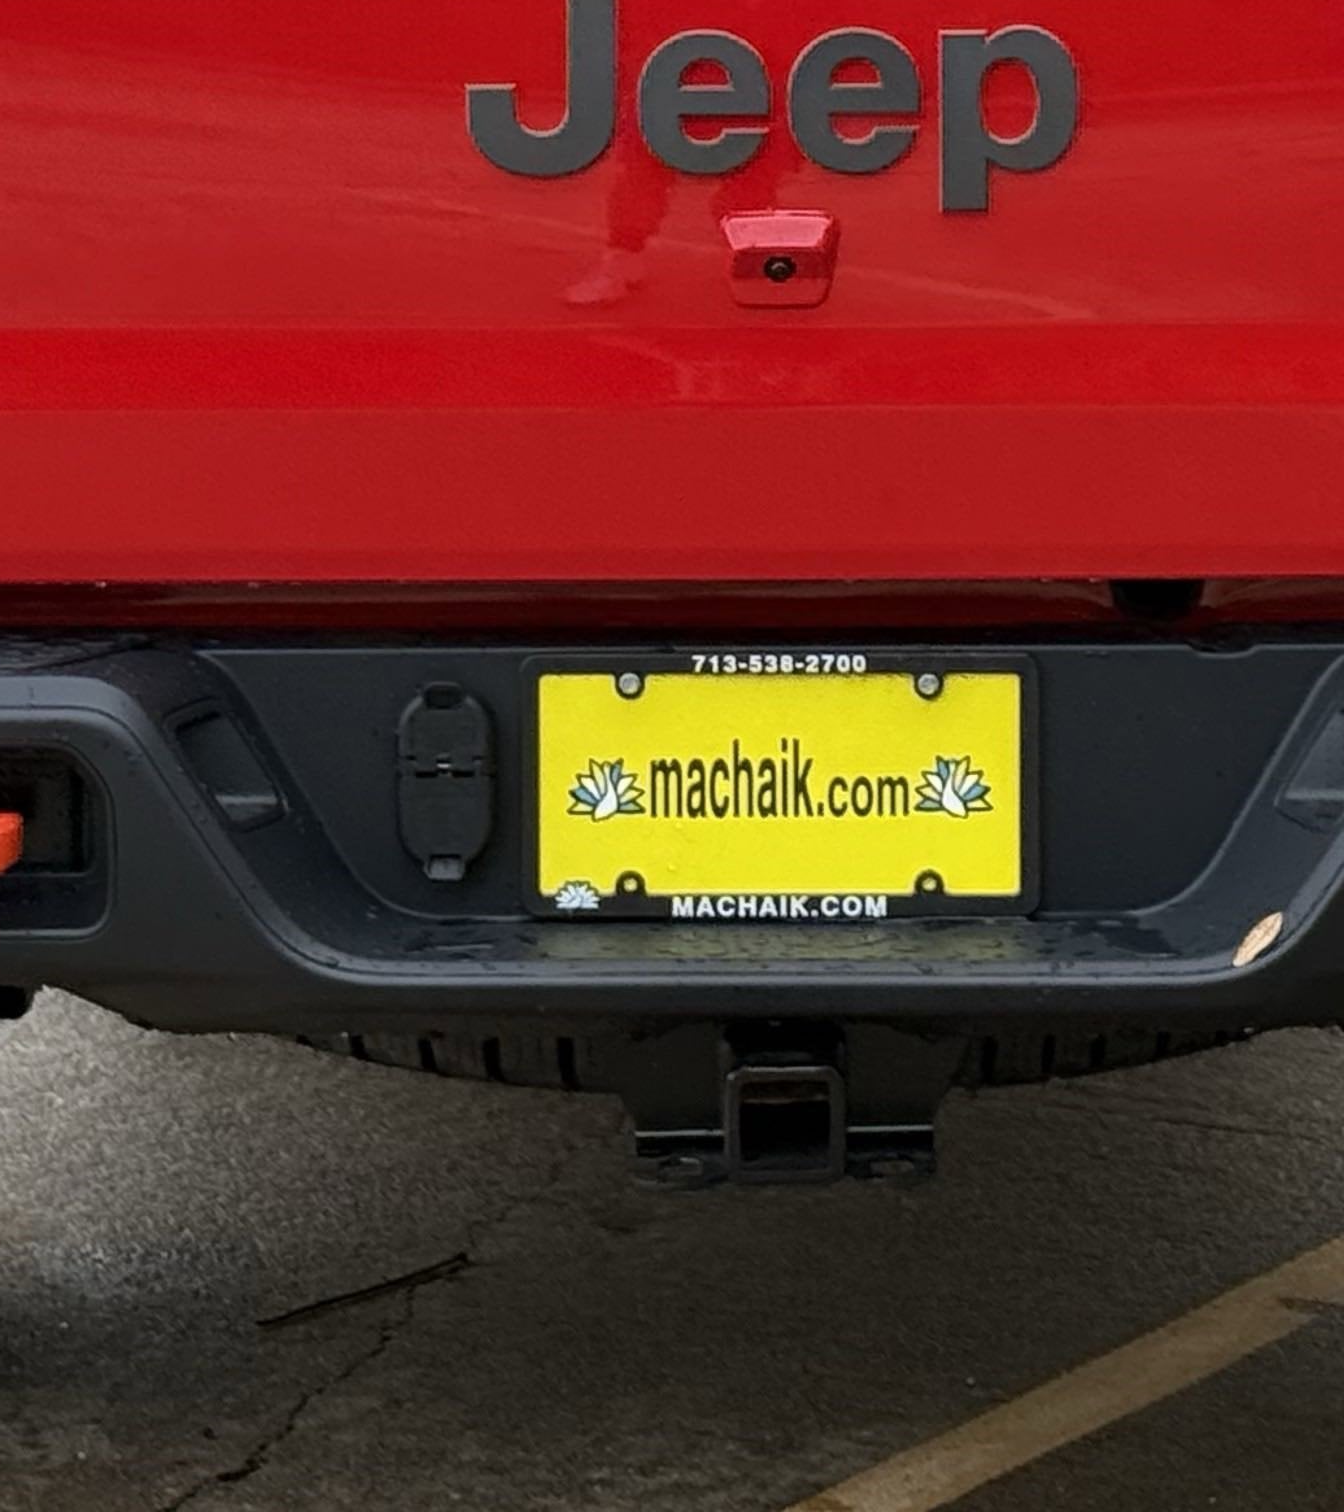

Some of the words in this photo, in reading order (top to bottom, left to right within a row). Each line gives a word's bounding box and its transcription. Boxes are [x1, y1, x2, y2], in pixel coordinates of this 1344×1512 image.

[691, 654, 868, 673] 713-538-2700
[650, 737, 910, 819] machaik.com
[671, 895, 888, 919] MACHAIK.COM
